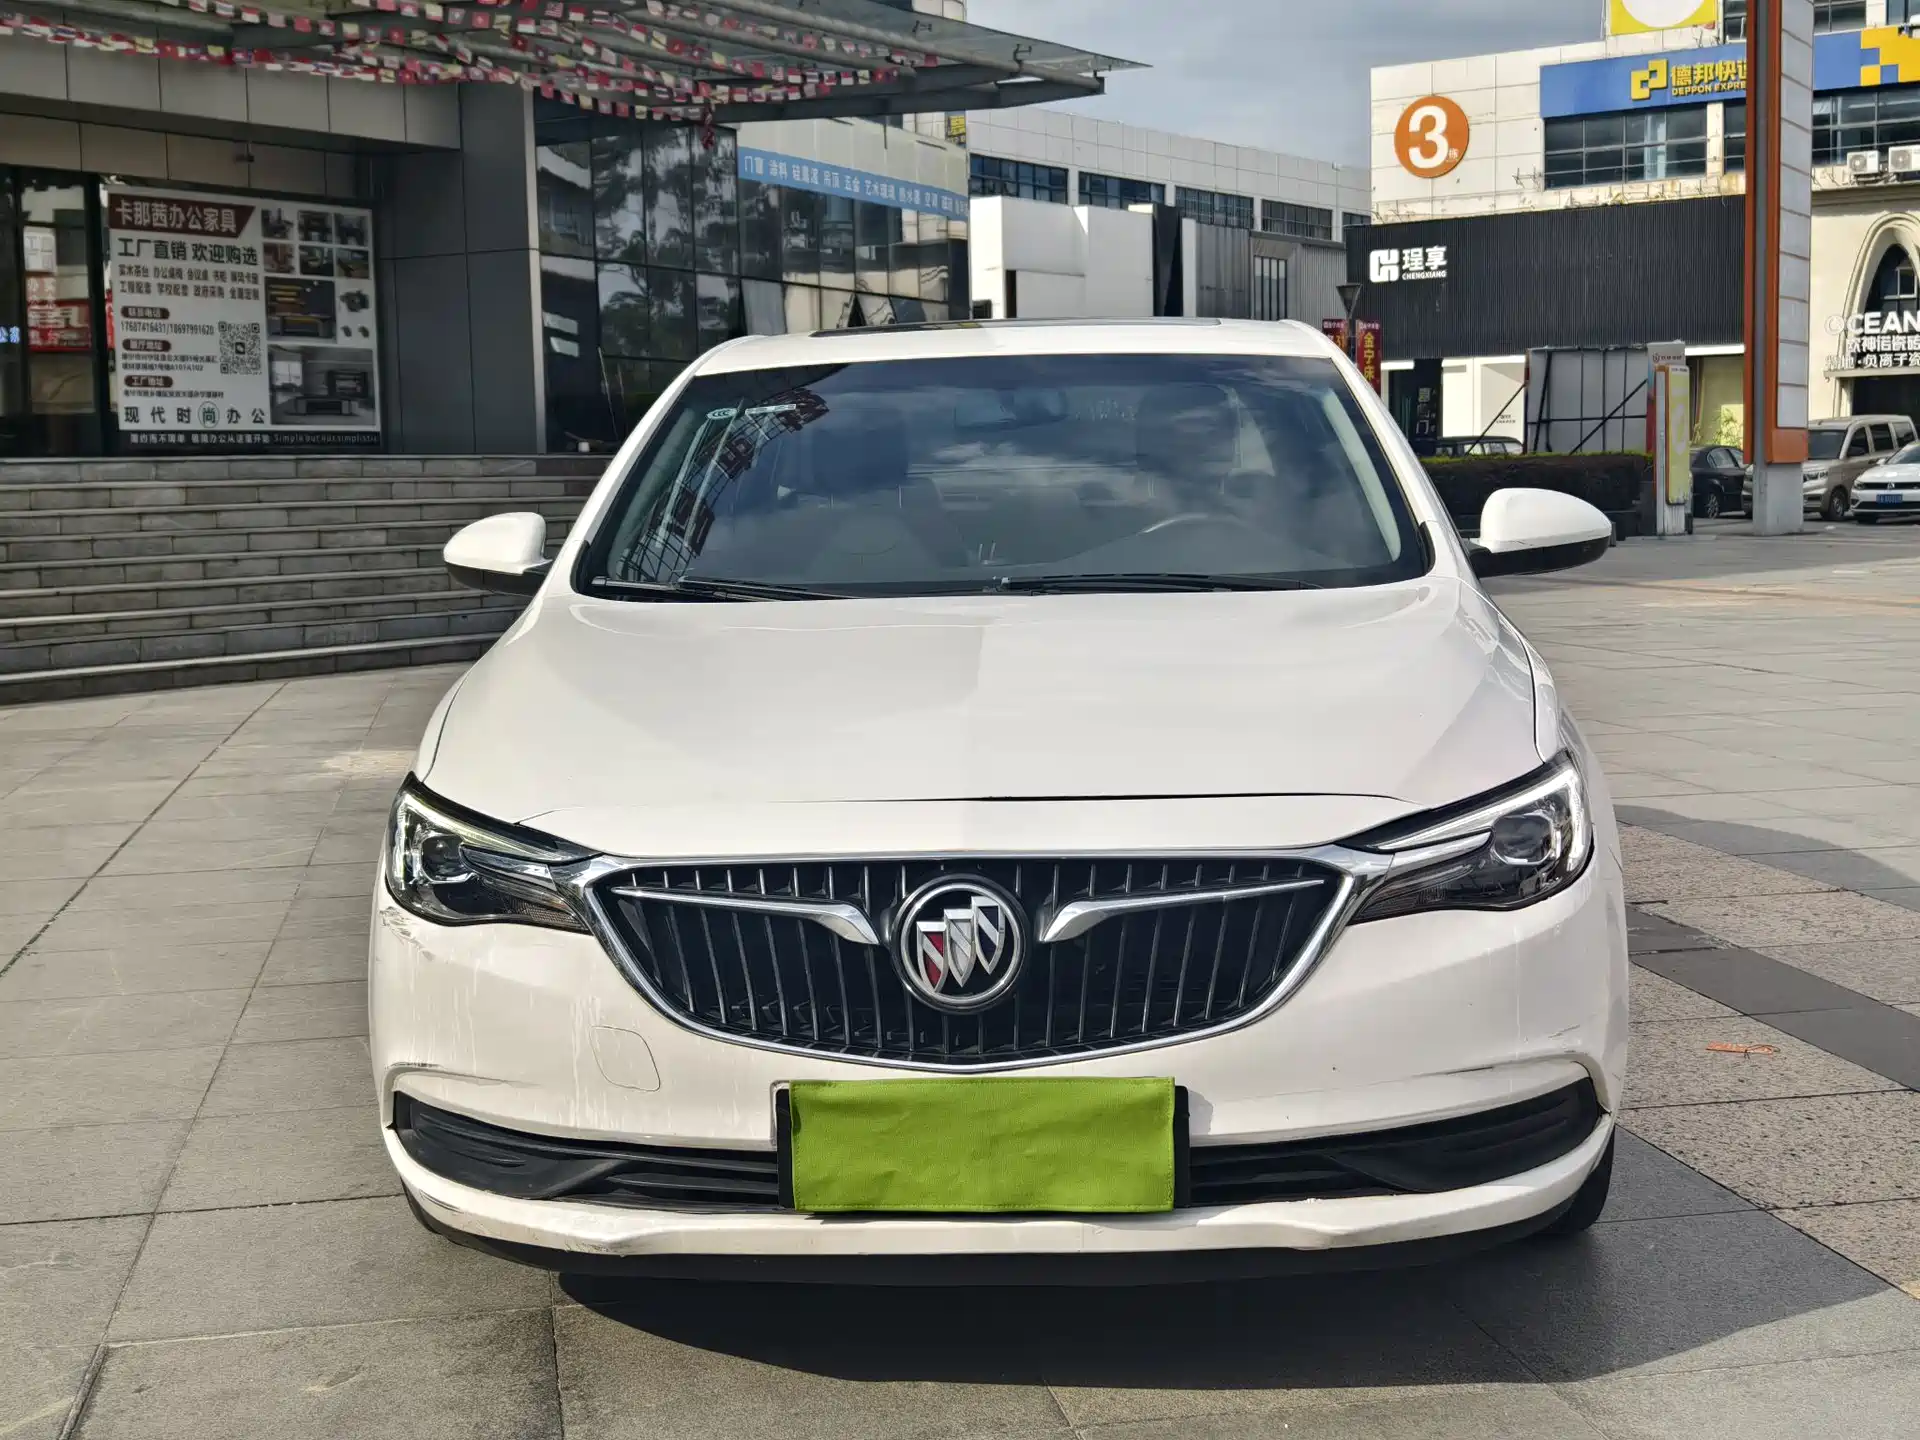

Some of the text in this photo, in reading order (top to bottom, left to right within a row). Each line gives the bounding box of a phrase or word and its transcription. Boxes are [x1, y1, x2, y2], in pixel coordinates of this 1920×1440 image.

[1671, 85, 1711, 96] DEPPON
[1409, 105, 1449, 168] 3
[116, 200, 237, 233] 卡那茜办公家具
[118, 238, 258, 265] 工厂直销 欢迎购选
[1402, 270, 1447, 281] CHENGXIANG
